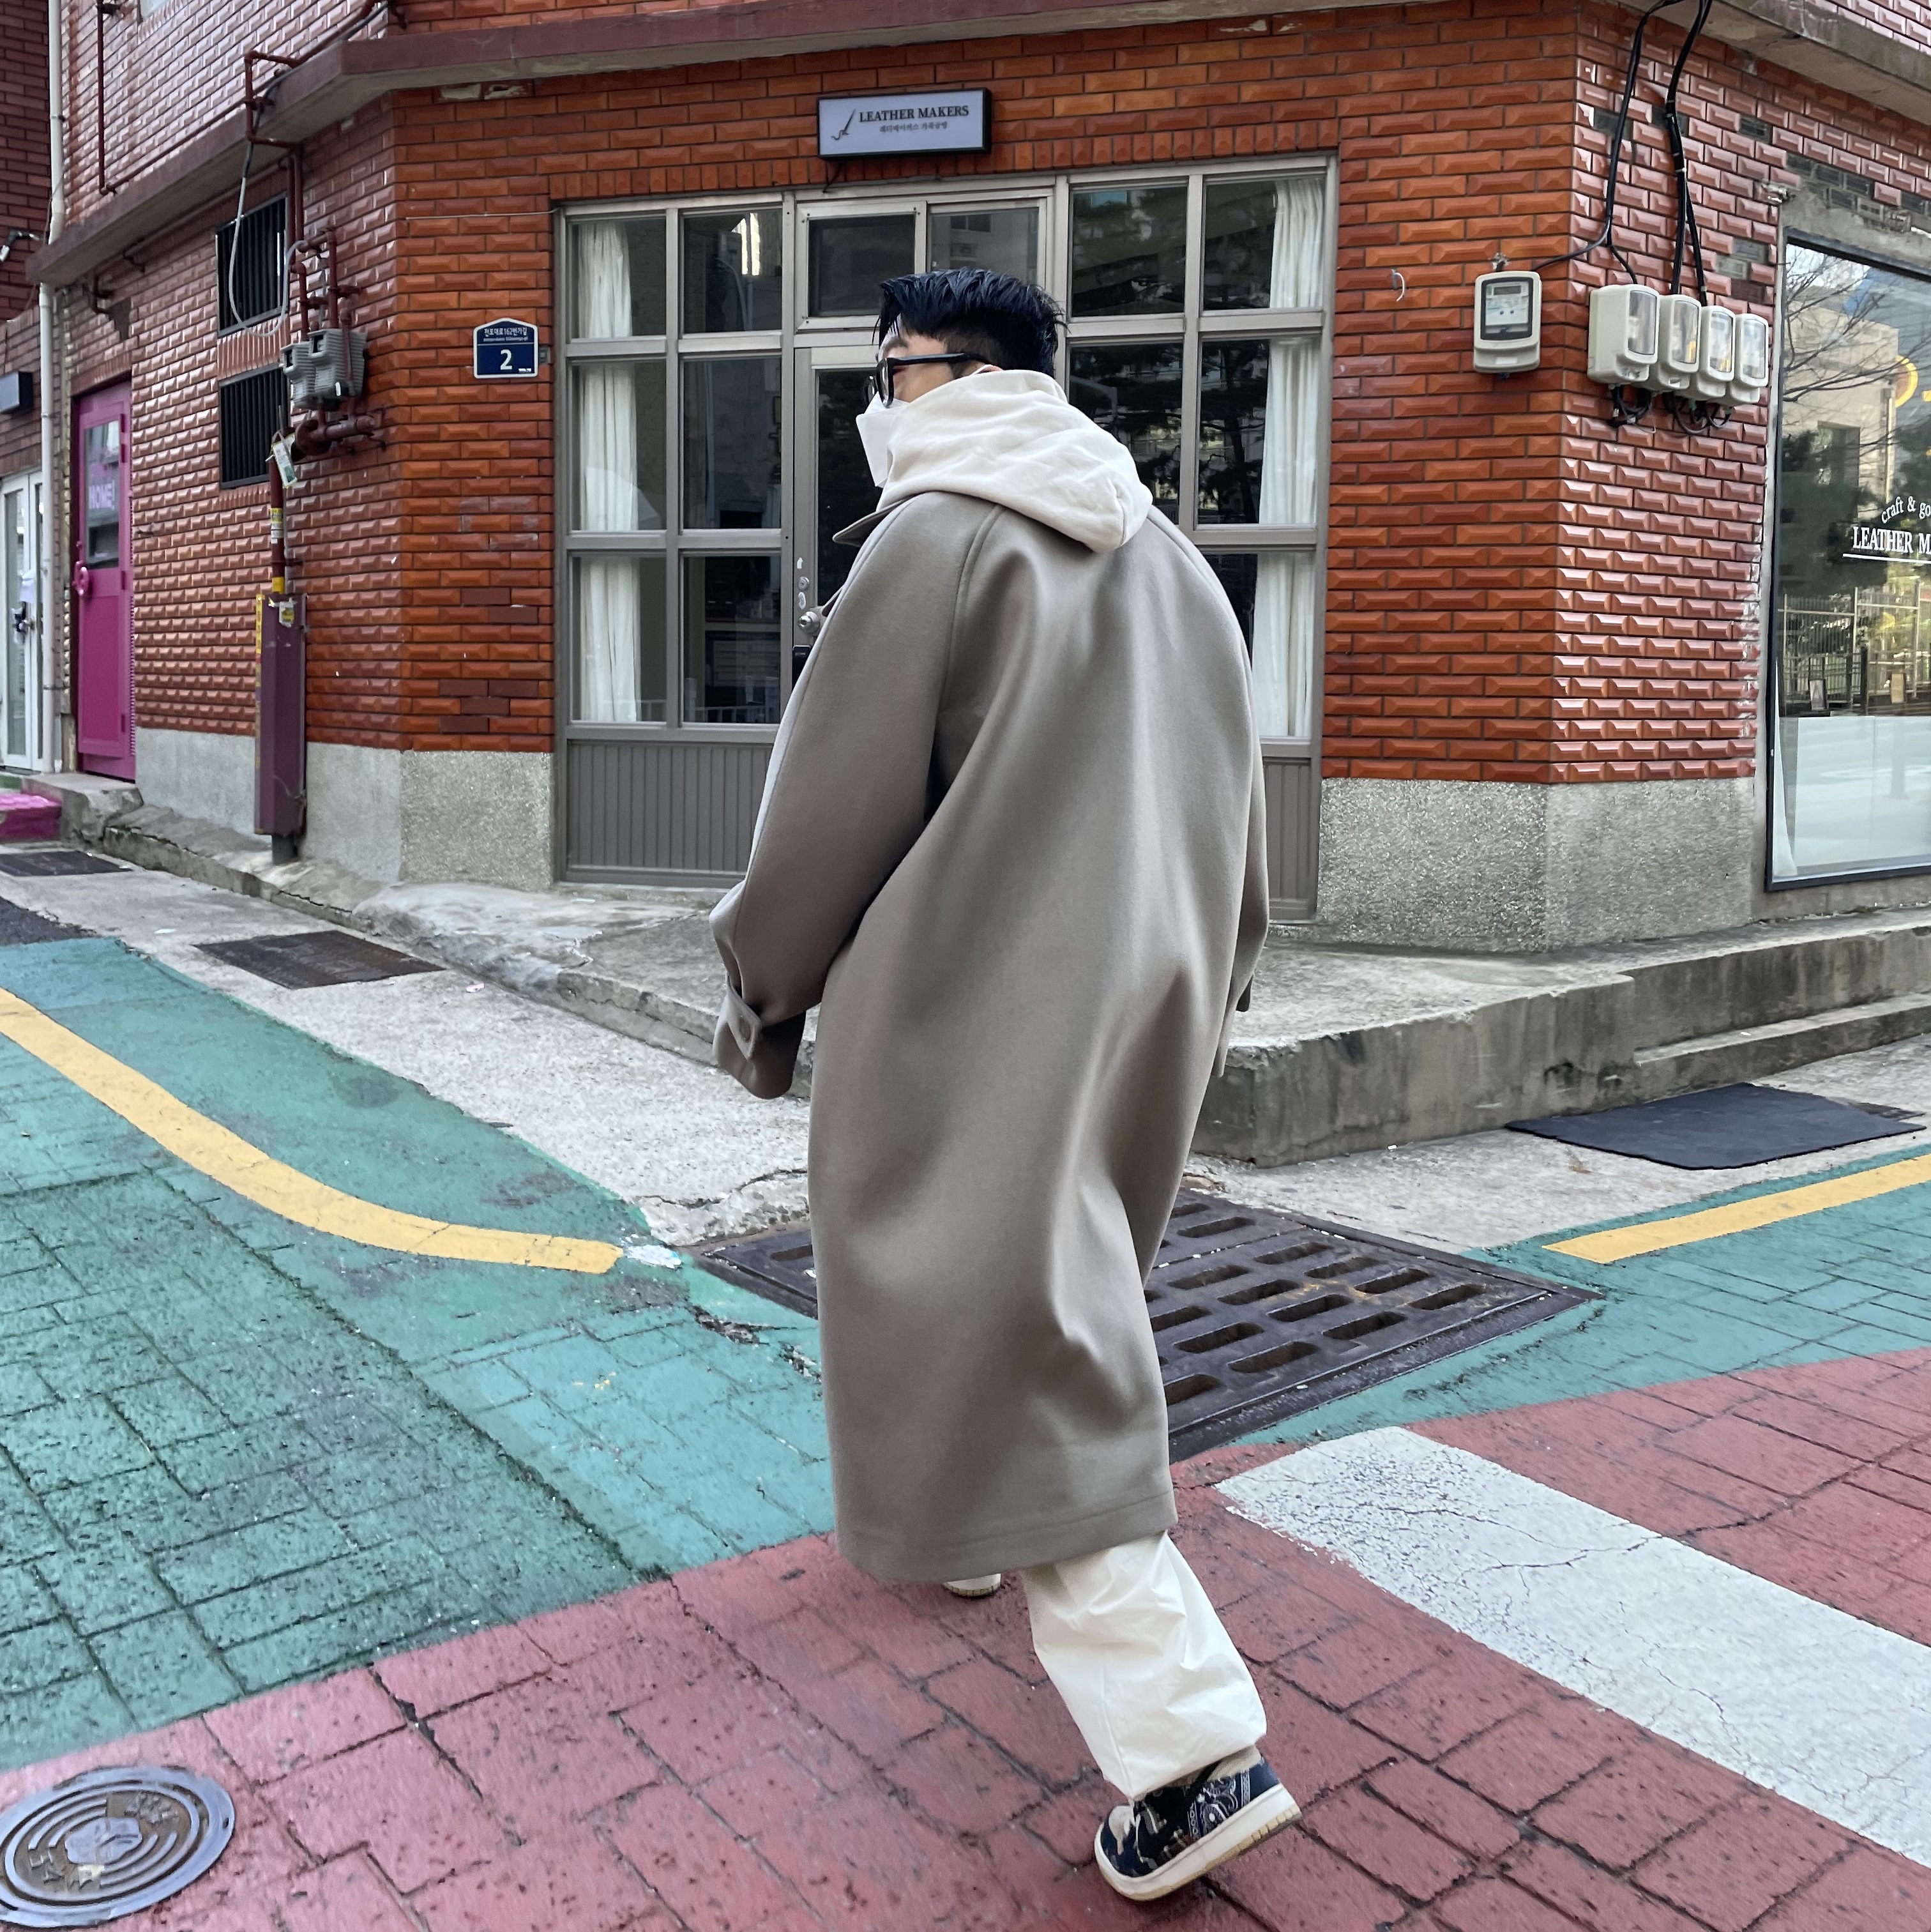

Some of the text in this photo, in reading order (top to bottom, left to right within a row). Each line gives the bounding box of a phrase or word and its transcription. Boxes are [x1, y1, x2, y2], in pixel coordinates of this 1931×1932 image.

[859, 105, 969, 123] LEATHER MAKERS
[500, 349, 513, 370] 2
[1881, 496, 1904, 524] craft
[1907, 496, 1916, 512] &
[1852, 526, 1914, 554] LEATHER
